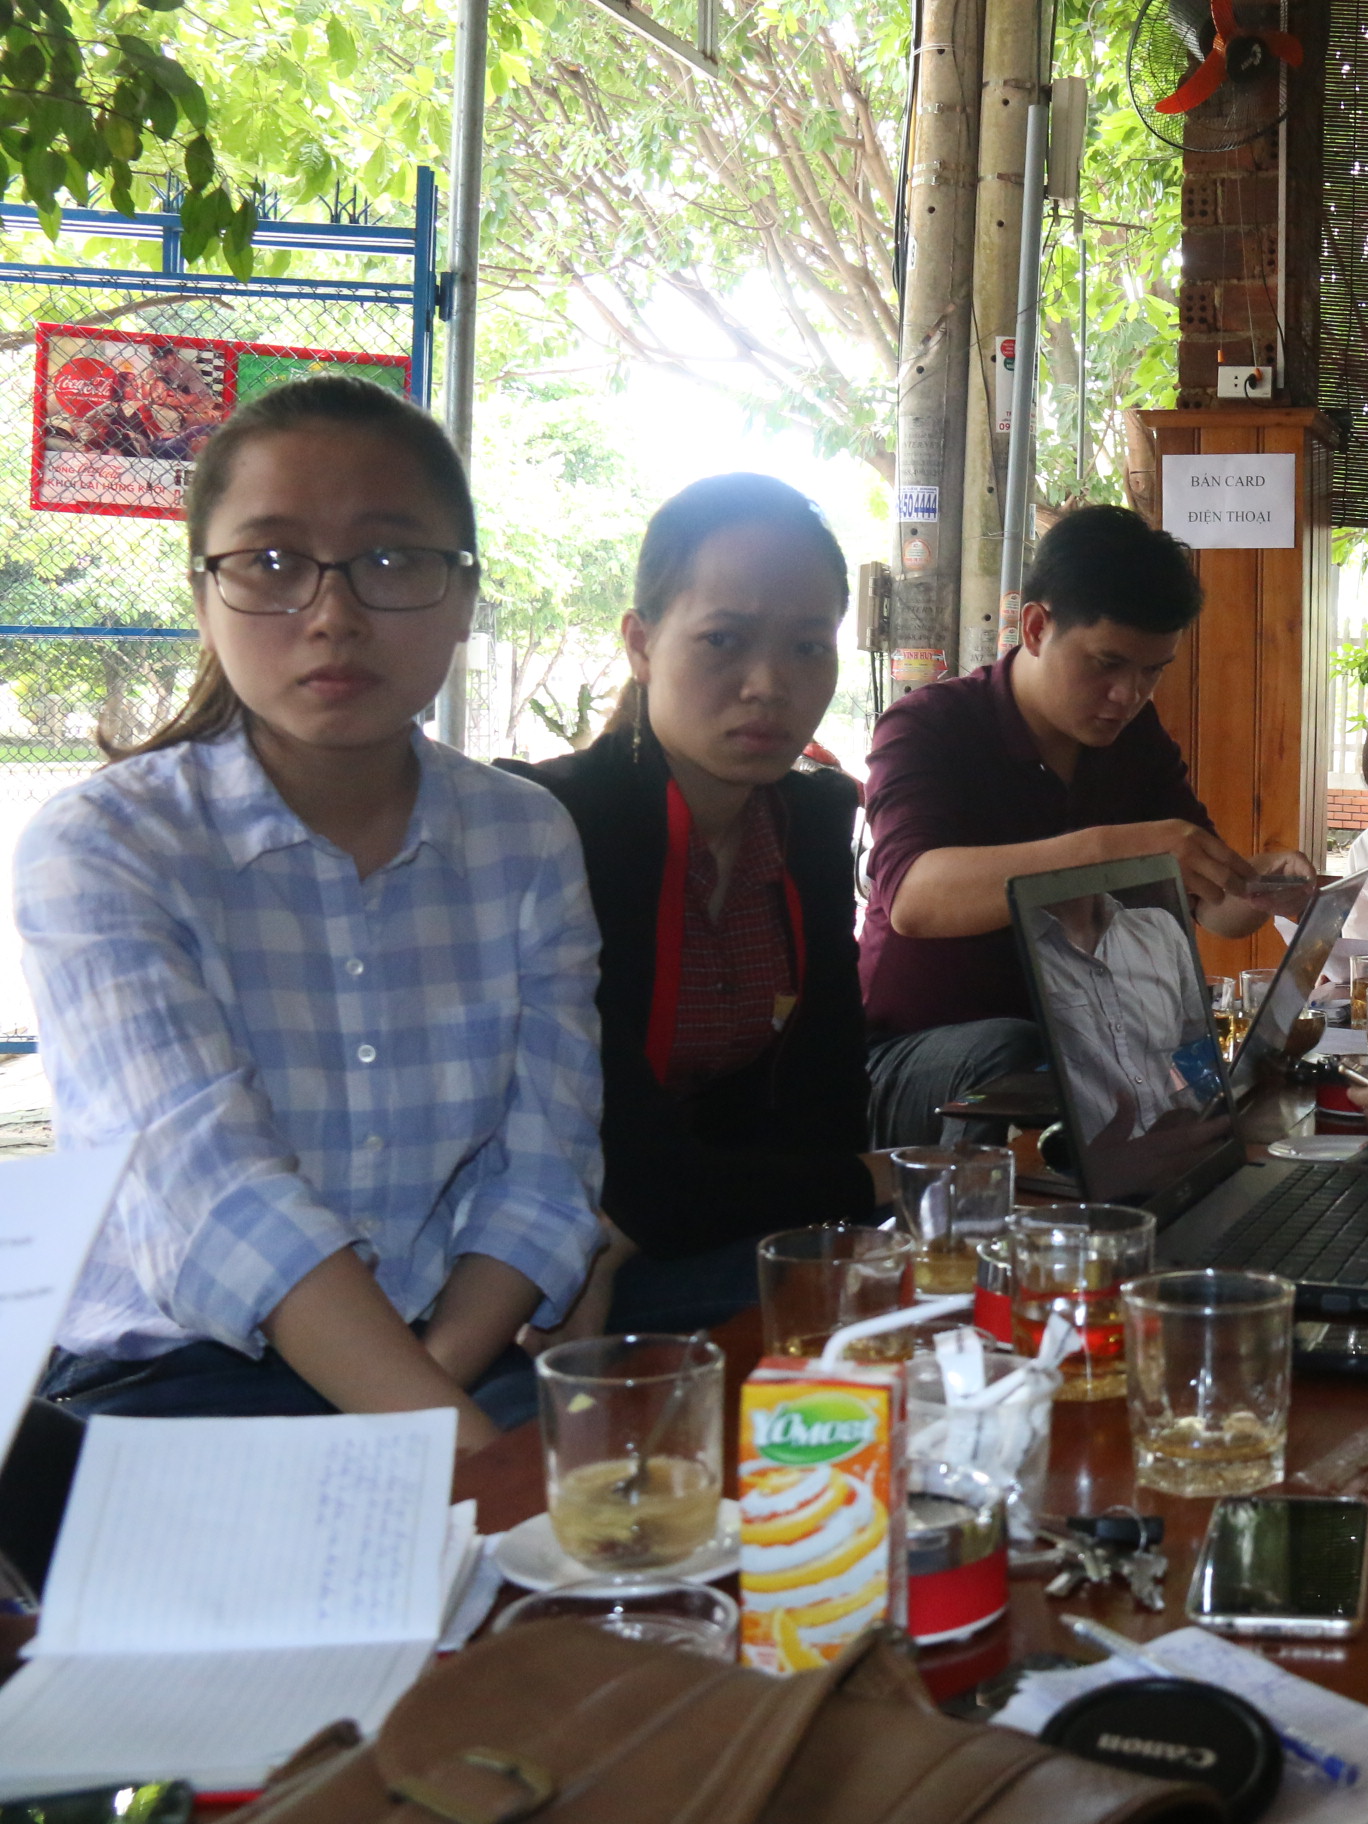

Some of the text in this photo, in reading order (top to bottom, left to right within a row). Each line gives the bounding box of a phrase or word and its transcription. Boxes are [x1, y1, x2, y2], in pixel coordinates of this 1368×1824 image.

[1190, 472, 1266, 487] BÁN CARD
[1188, 509, 1272, 525] ĐIỆN THOẠI
[1097, 1733, 1217, 1770] Canon
